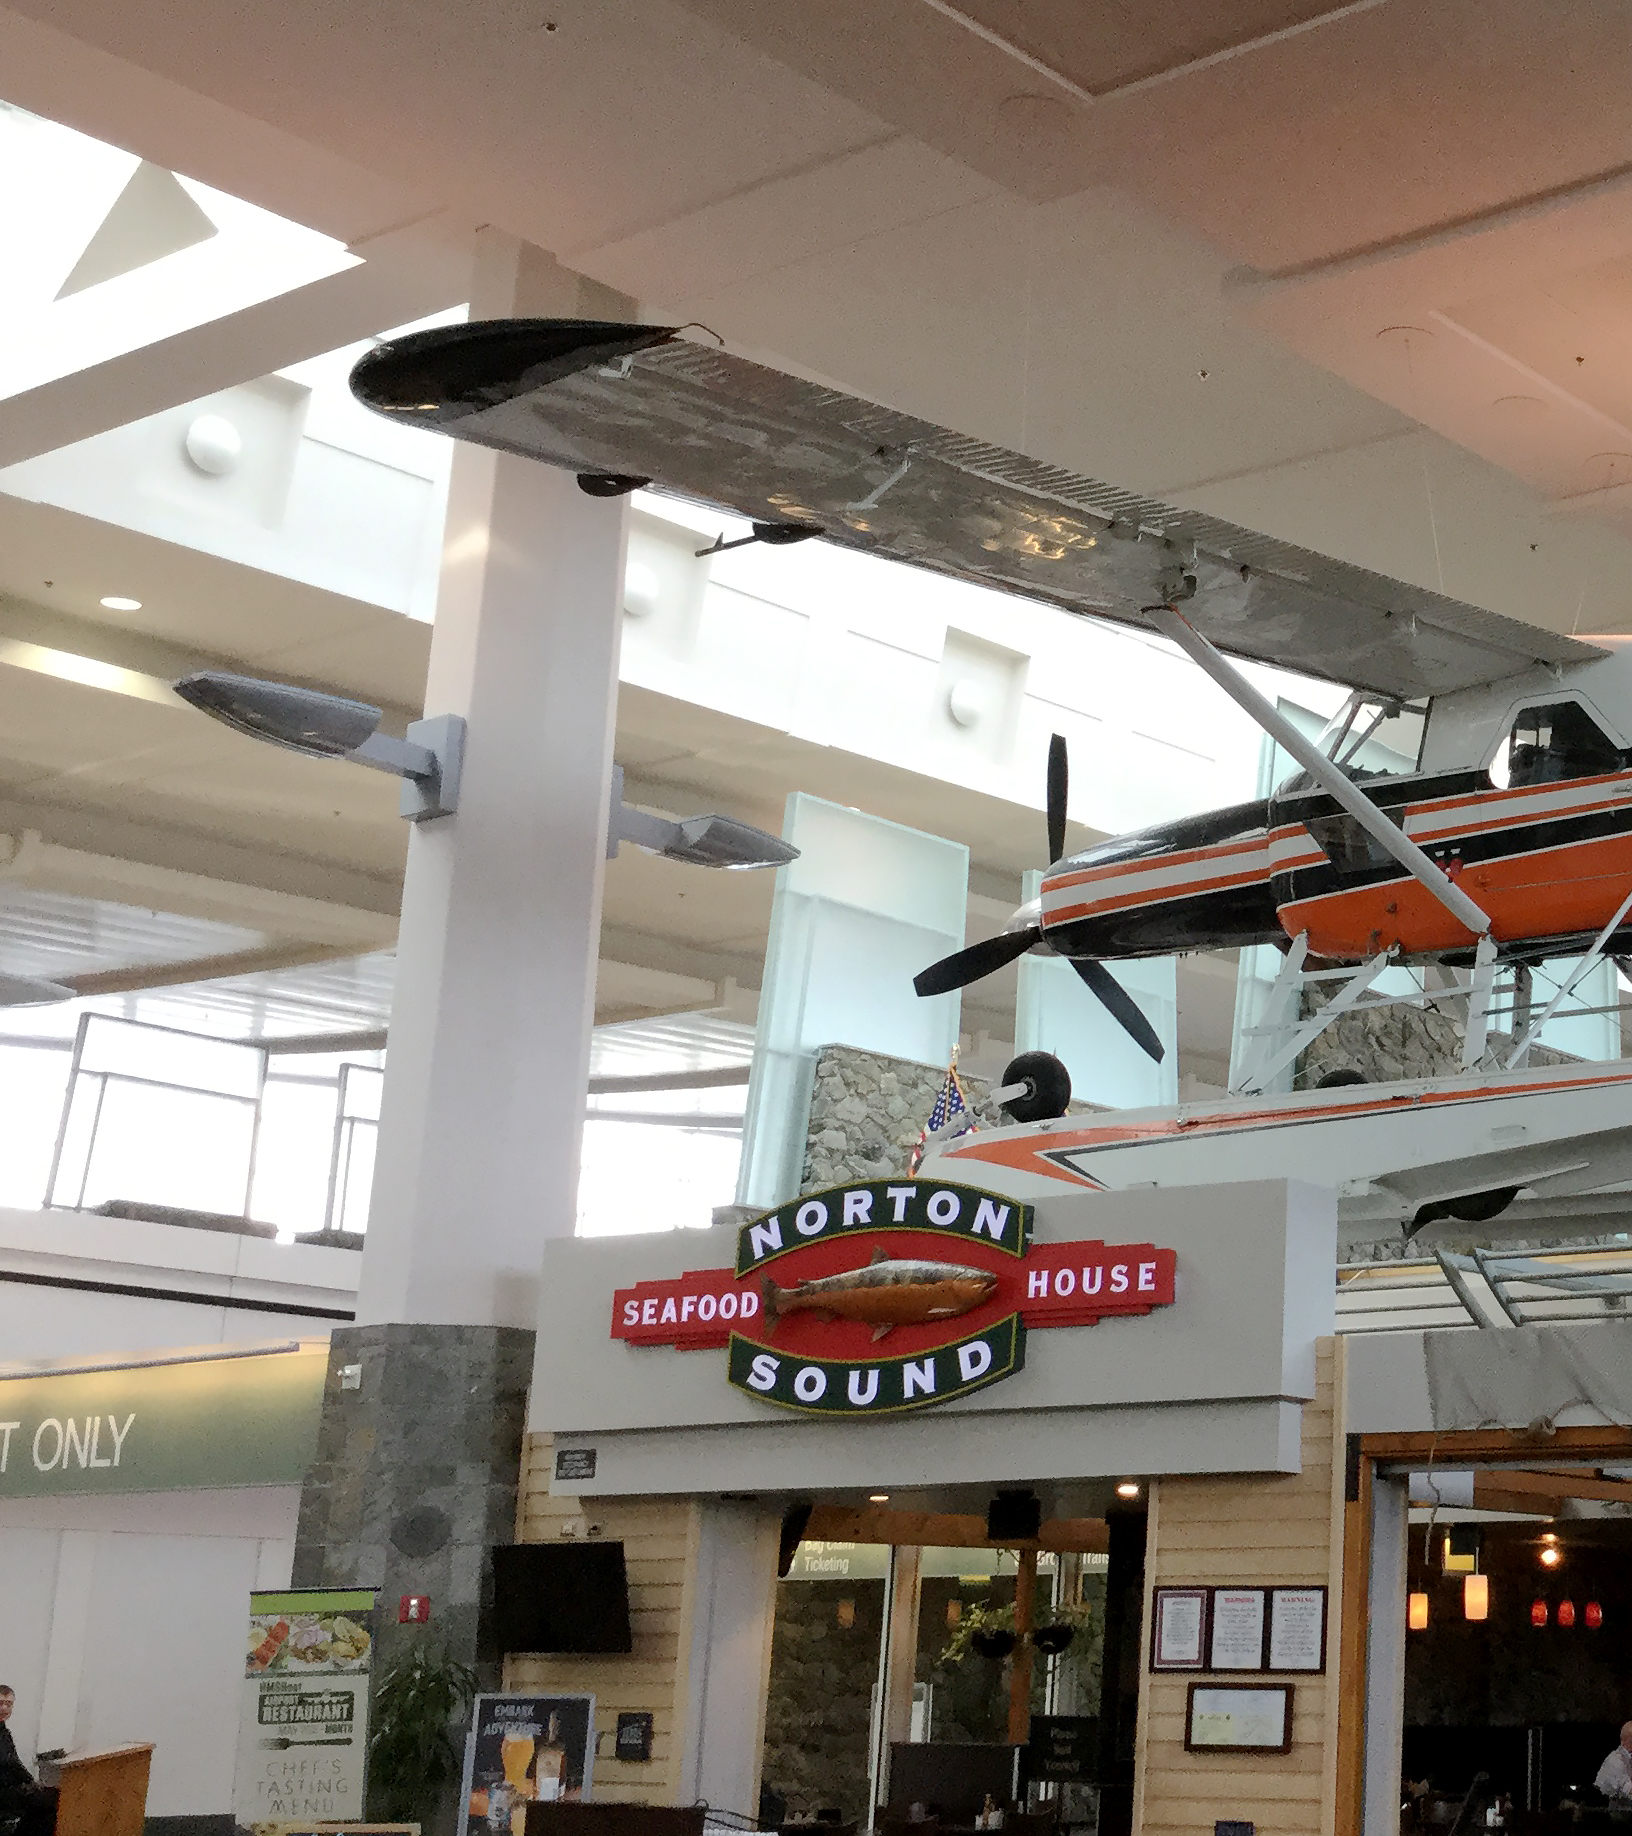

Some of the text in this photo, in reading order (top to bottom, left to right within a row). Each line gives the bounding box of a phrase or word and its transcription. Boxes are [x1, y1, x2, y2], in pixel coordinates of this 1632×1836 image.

[748, 1186, 1011, 1262] NORTON
[1027, 1261, 1157, 1298] HOUSE
[623, 1291, 760, 1326] SEAFOOD
[746, 1339, 993, 1407] SOUND
[33, 1413, 136, 1471] ONLY
[805, 1556, 850, 1575] Ticketing
[262, 1704, 350, 1723] RESTAURANT
[265, 1759, 342, 1777] CHEF'S
[256, 1778, 348, 1798] TASTING
[269, 1799, 334, 1816] MENU
